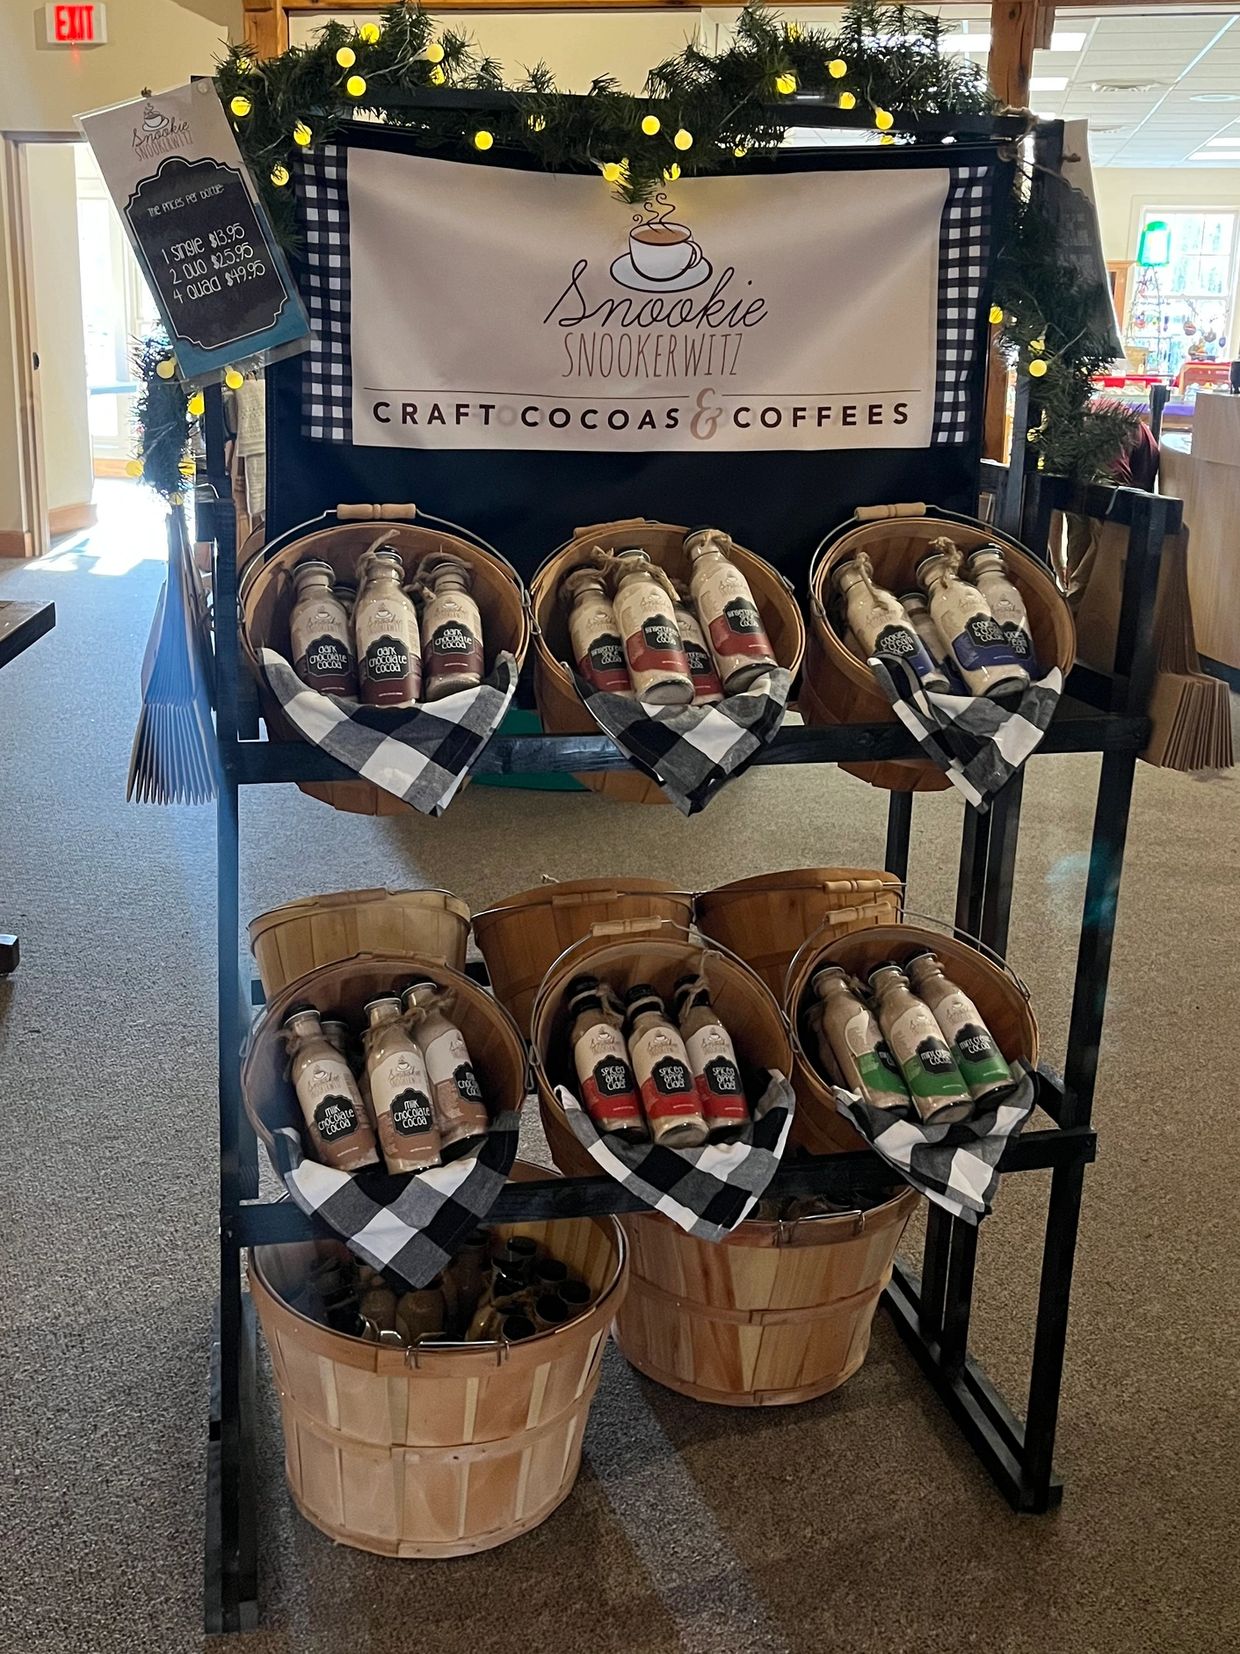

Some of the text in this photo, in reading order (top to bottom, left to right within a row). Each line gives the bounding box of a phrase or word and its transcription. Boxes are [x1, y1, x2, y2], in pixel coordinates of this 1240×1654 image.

[55, 5, 94, 41] EXIT
[132, 116, 190, 148] Snookie
[161, 248, 170, 265] 1
[208, 222, 245, 248] $13.95
[169, 268, 182, 285] 2
[211, 242, 254, 269] $25.95
[173, 288, 183, 304] 4
[225, 259, 266, 287] $49.95
[543, 259, 769, 329] Snookie
[562, 331, 743, 378] SNOOKERWITZ
[372, 387, 909, 441] CRAFT COCOAS & COFFEES
[317, 661, 342, 670] cocoa
[375, 662, 401, 674] cocoa
[326, 1119, 351, 1135] cocoa
[402, 1116, 428, 1129] cocoa
